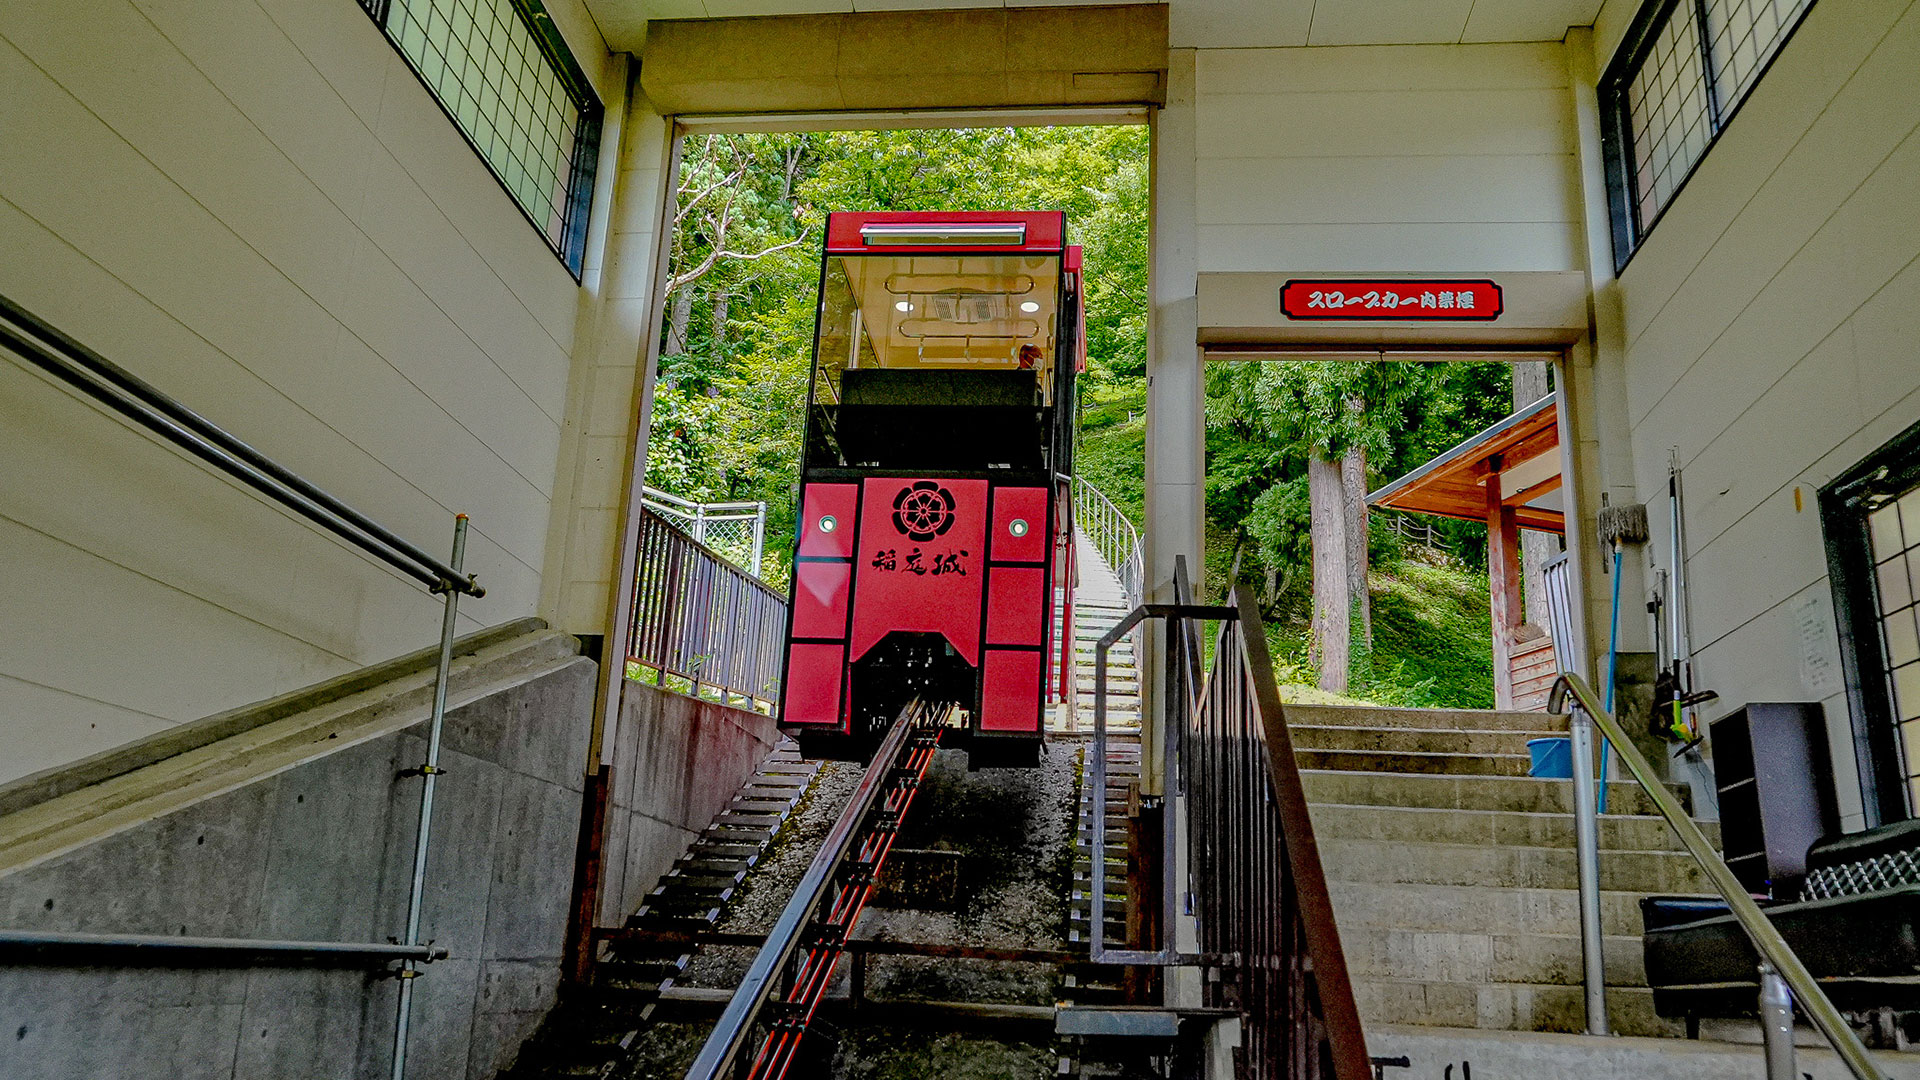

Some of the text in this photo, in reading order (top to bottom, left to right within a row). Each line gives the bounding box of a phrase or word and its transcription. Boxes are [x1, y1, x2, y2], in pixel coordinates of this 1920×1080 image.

[1307, 290, 1475, 309] スロープカー内禁煙
[872, 547, 969, 576] 稲庭城
